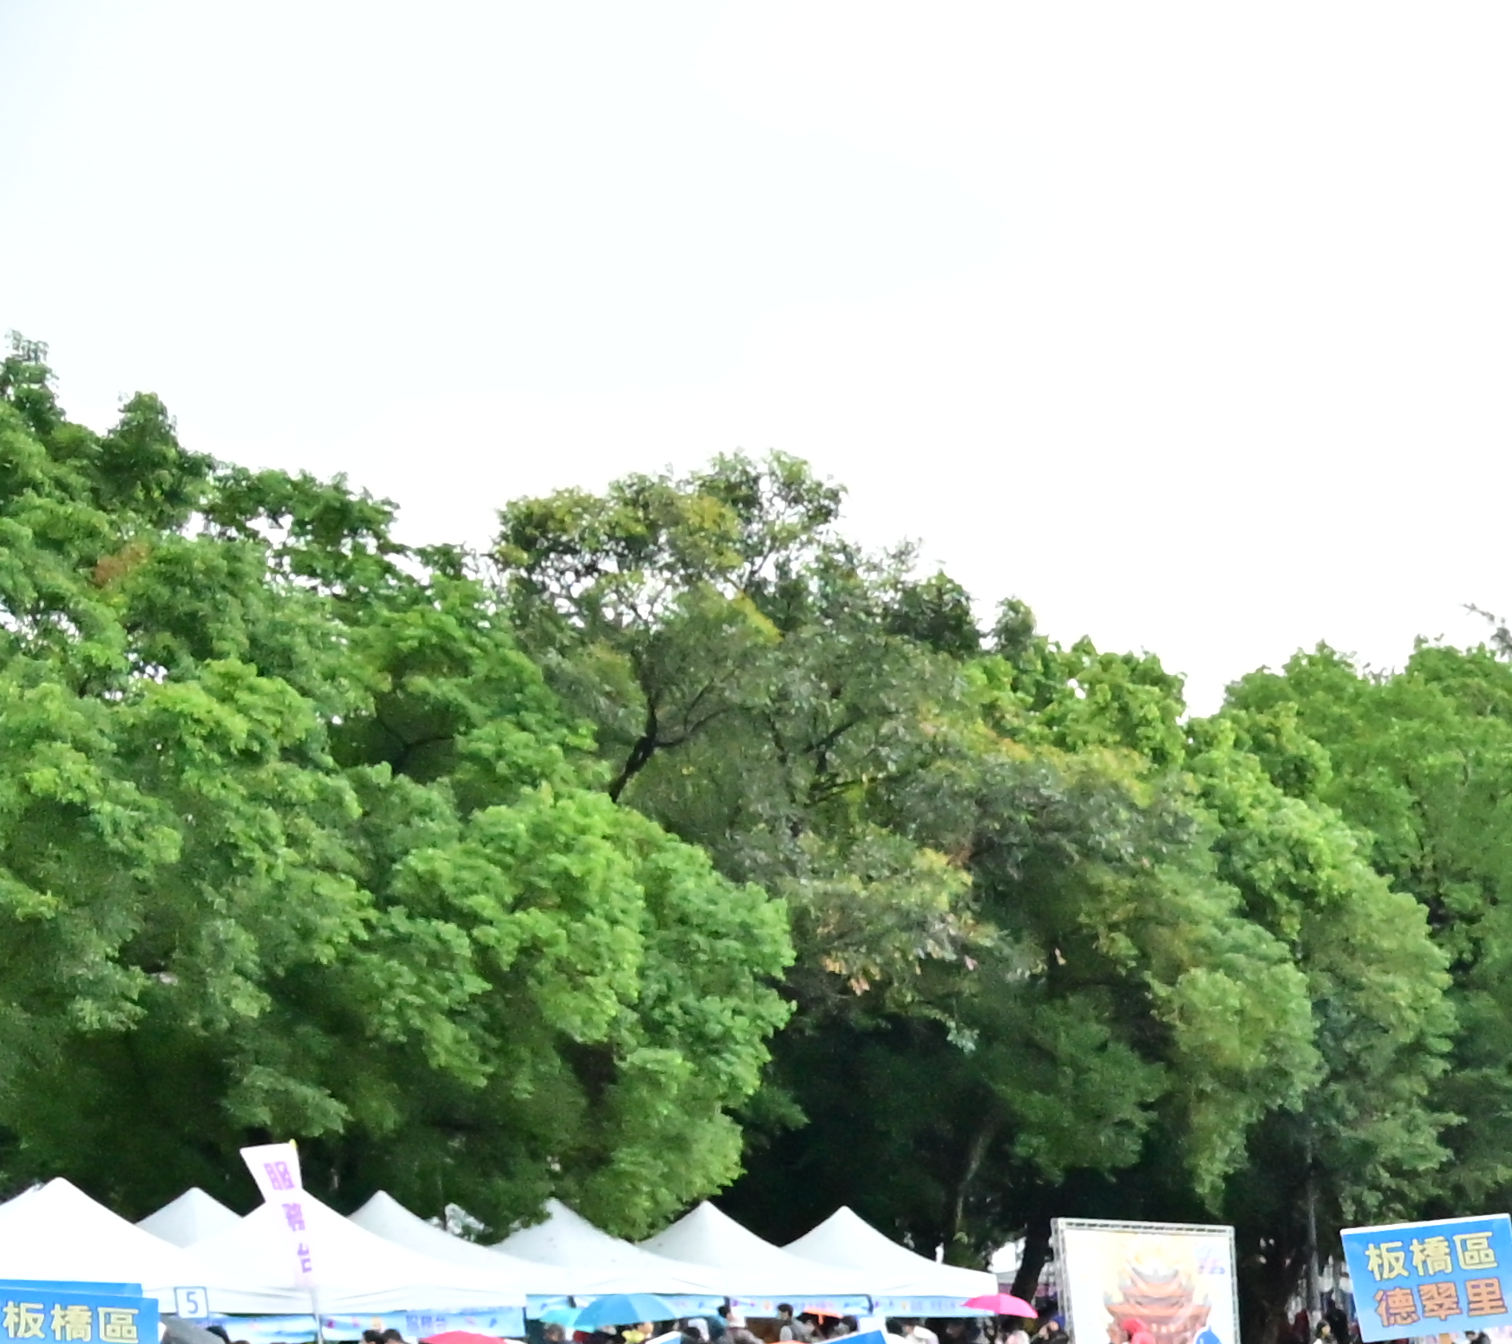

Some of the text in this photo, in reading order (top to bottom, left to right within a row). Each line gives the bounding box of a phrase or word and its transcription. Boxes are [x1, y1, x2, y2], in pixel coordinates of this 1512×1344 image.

[1365, 1231, 1498, 1281] 板橋區
[2, 1301, 139, 1344] 板橋區
[186, 1295, 203, 1315] 5
[1373, 1276, 1508, 1327] 德翠里
